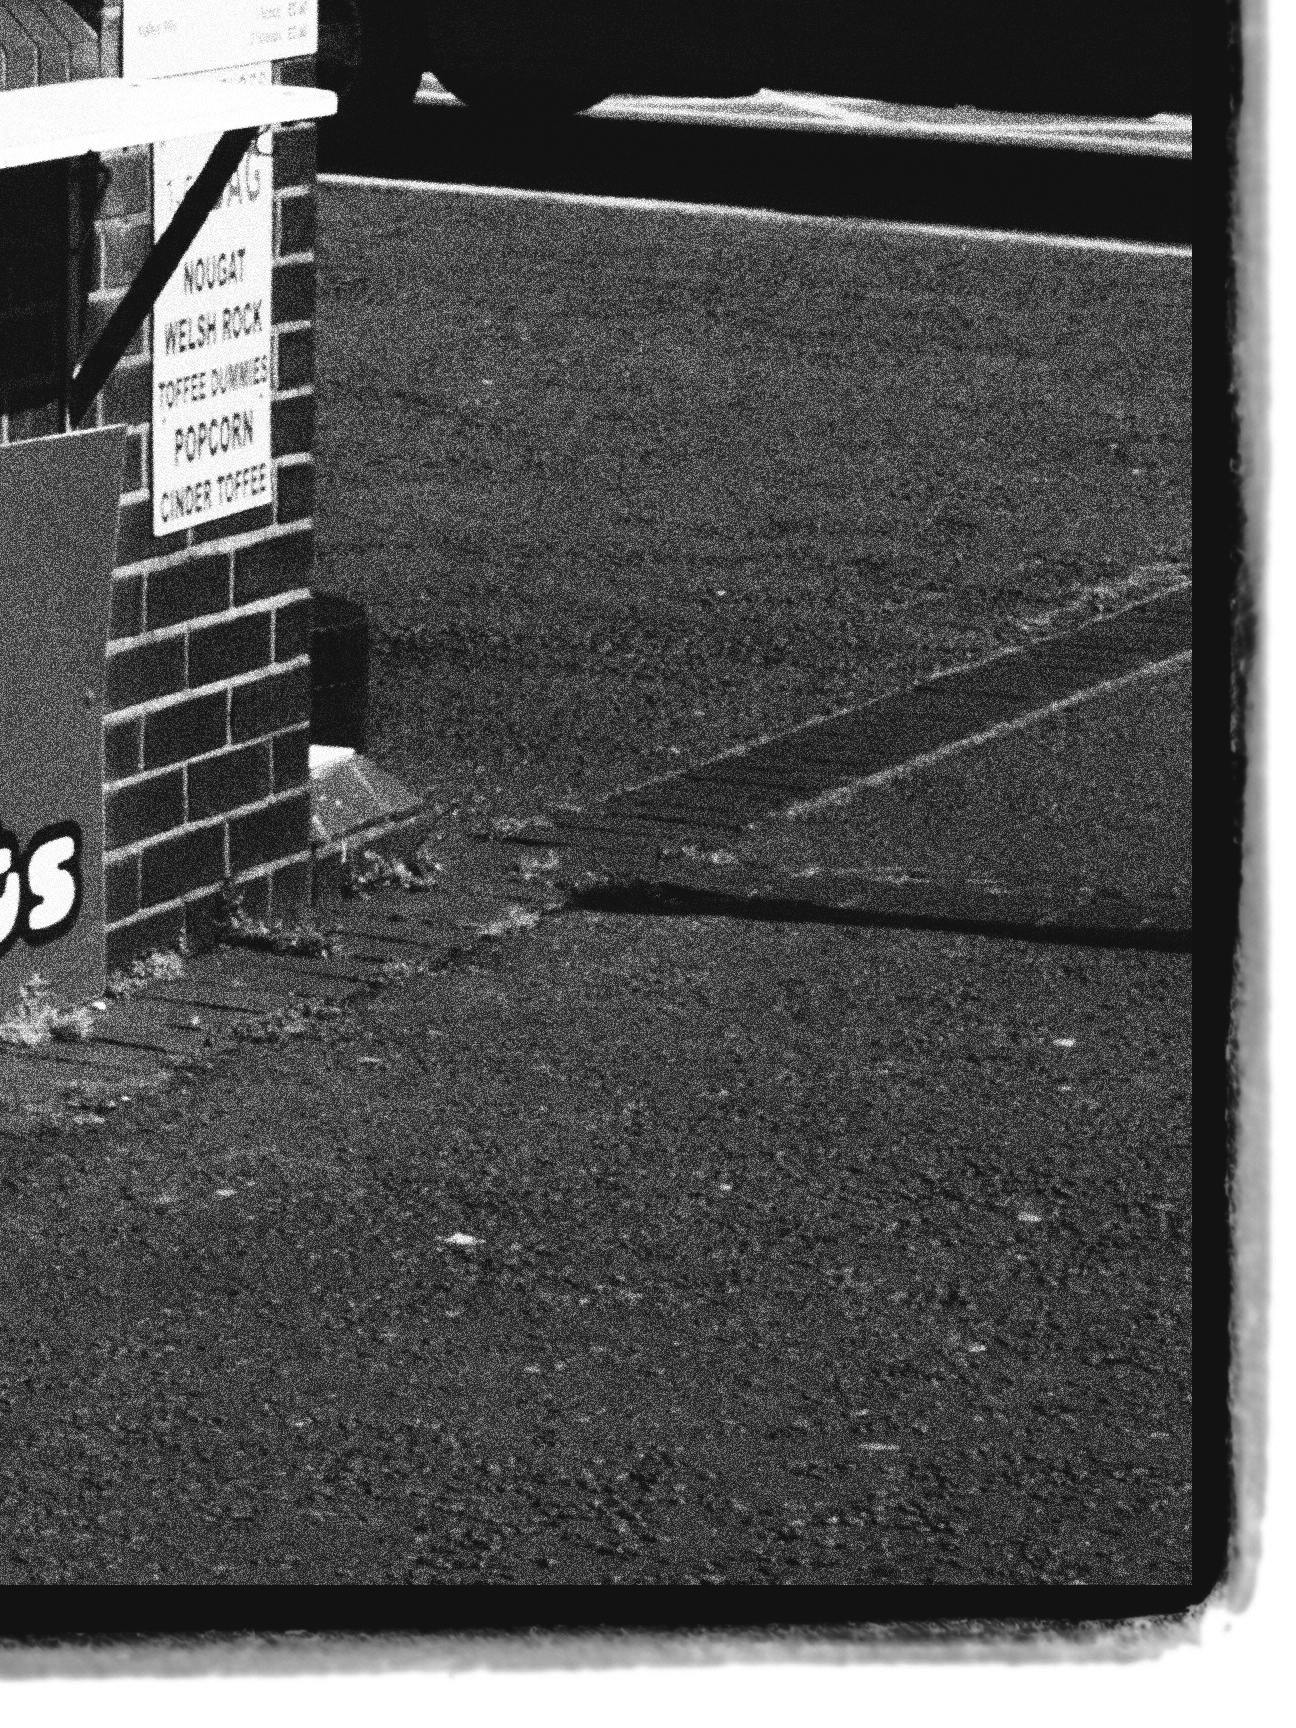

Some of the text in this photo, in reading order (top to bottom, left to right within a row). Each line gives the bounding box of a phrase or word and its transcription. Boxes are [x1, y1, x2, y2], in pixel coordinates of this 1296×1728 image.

[183, 247, 246, 295] NOUGAT
[164, 299, 263, 357] WELSH ROCK
[157, 354, 268, 410] TOFFEE DUMMIES
[174, 409, 255, 467] POPCORN
[160, 462, 267, 524] CINDER TOFFEE
